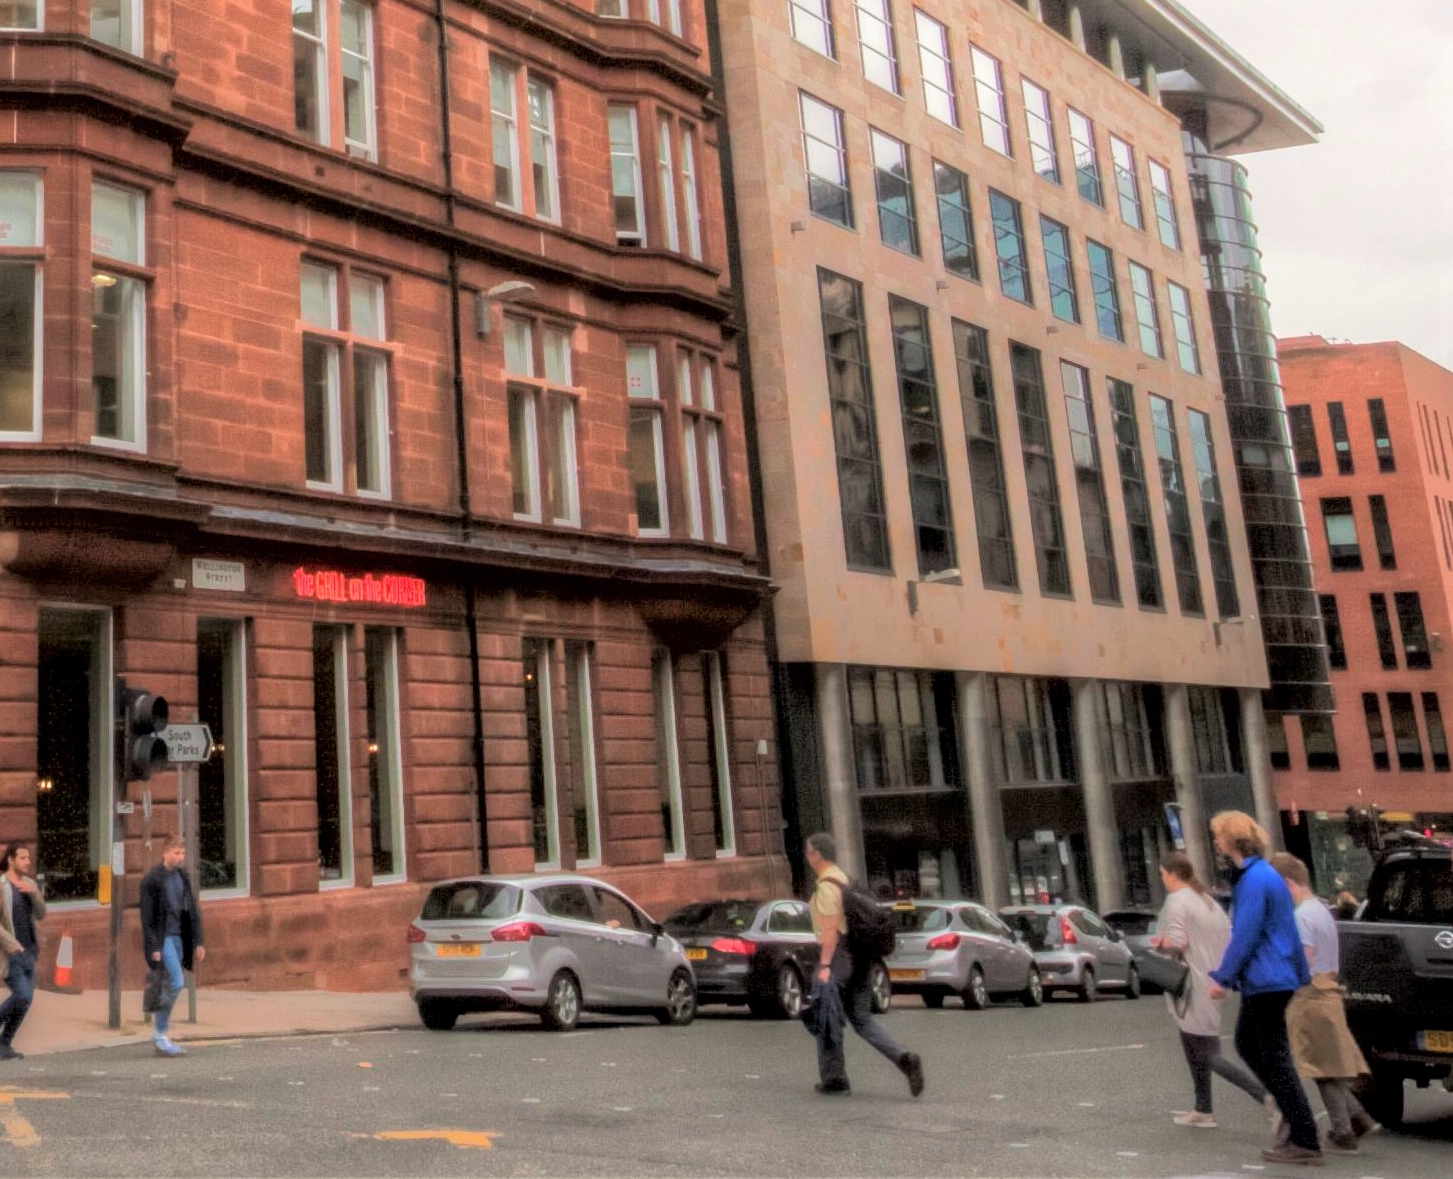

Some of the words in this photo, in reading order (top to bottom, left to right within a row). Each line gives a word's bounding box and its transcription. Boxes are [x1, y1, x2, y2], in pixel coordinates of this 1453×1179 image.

[293, 566, 314, 597] the
[315, 571, 347, 601] GRILL
[349, 578, 364, 601] on
[364, 573, 382, 601] the
[383, 574, 426, 606] CORNER
[168, 729, 192, 741] South
[177, 743, 200, 755] Parks
